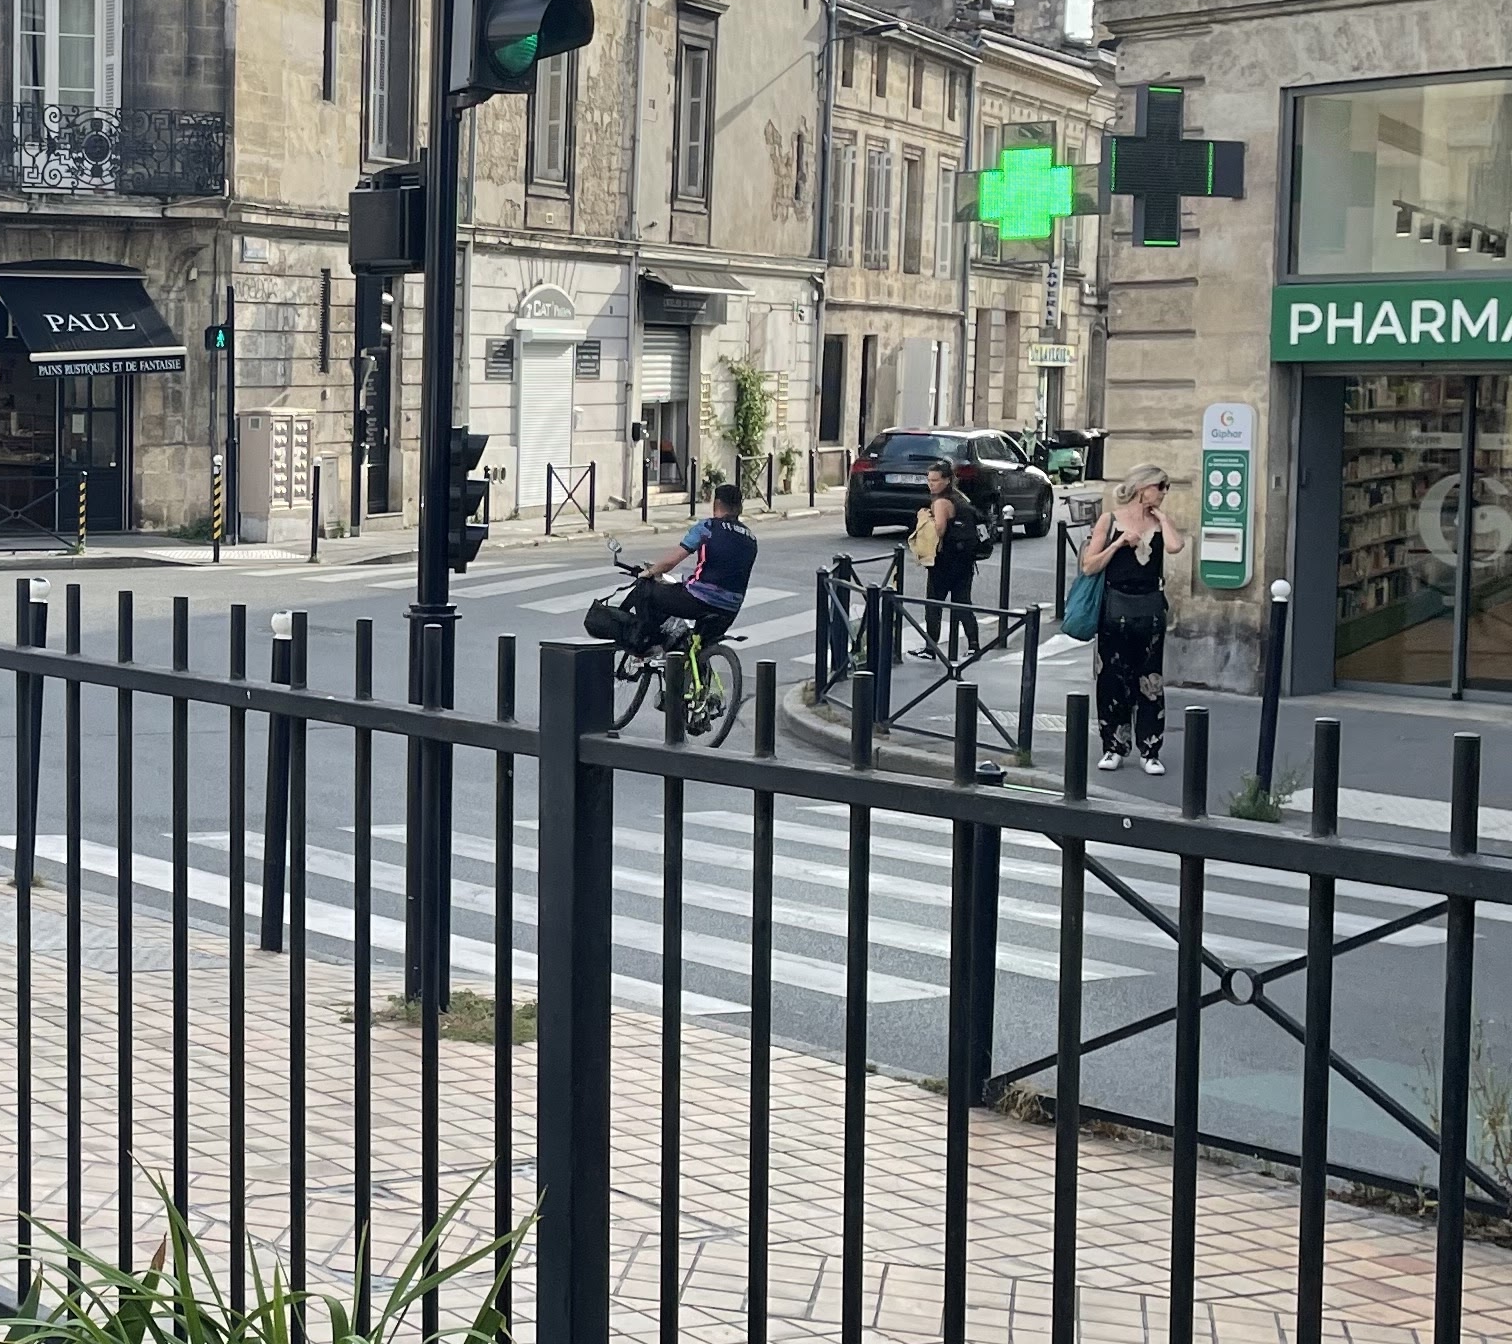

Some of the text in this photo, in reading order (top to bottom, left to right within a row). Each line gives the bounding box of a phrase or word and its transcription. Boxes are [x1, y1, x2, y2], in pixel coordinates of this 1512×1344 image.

[43, 312, 136, 333] PAUL
[38, 359, 182, 377] PAINS RUSTIQUES ET DE FANTAISIE
[1211, 428, 1242, 440] Giphar
